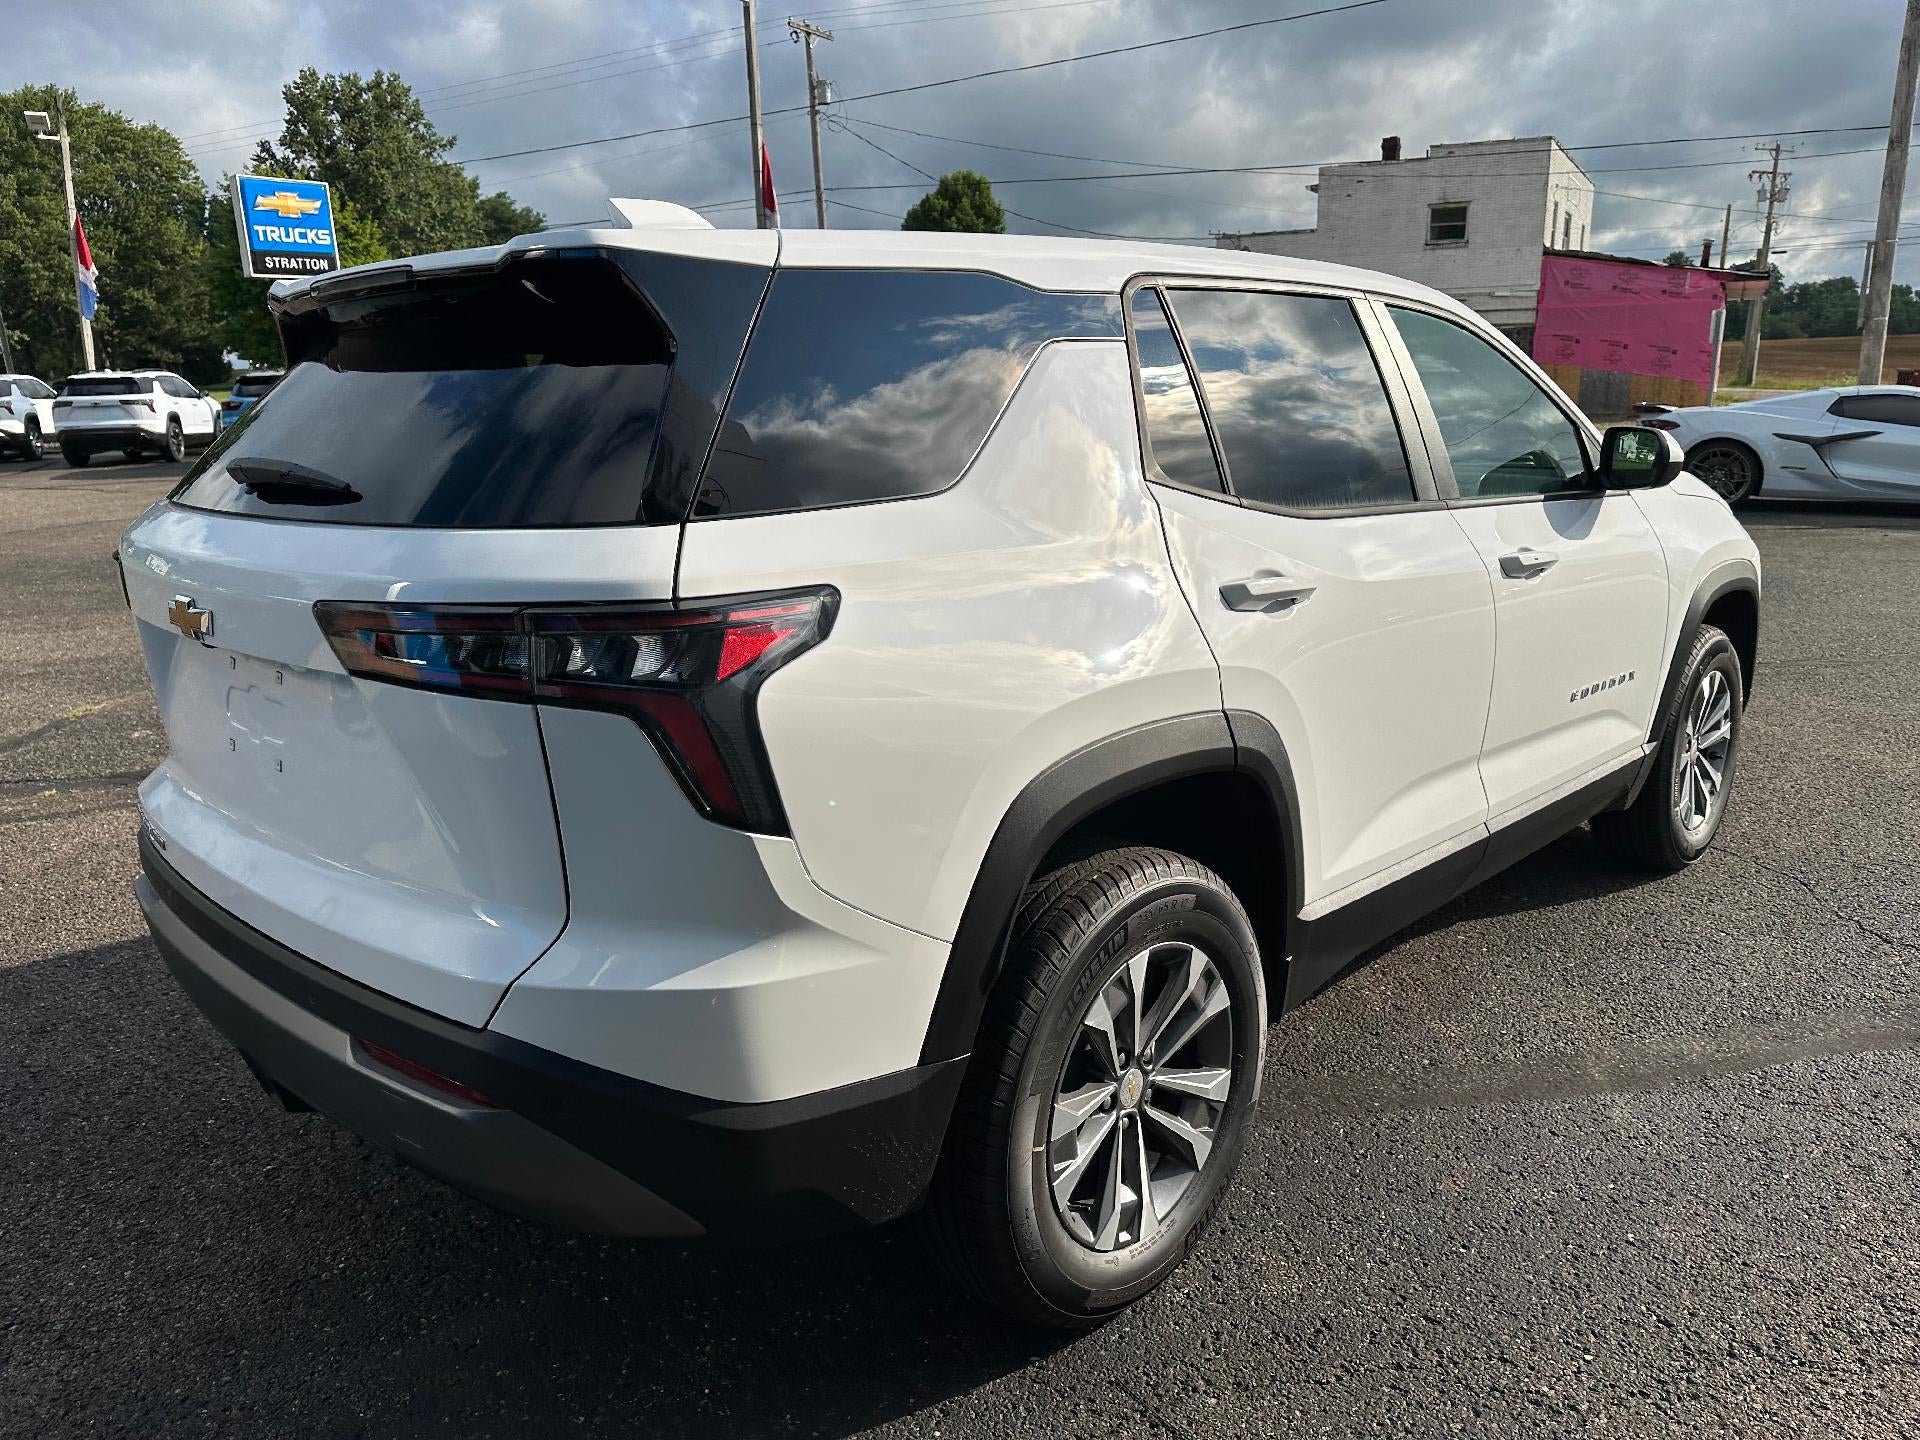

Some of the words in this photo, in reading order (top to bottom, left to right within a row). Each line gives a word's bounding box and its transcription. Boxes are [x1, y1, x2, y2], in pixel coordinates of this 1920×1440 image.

[253, 224, 331, 245] TRUCKS
[264, 256, 329, 271] STRATTON
[1056, 928, 1126, 1034] MICHELIN
